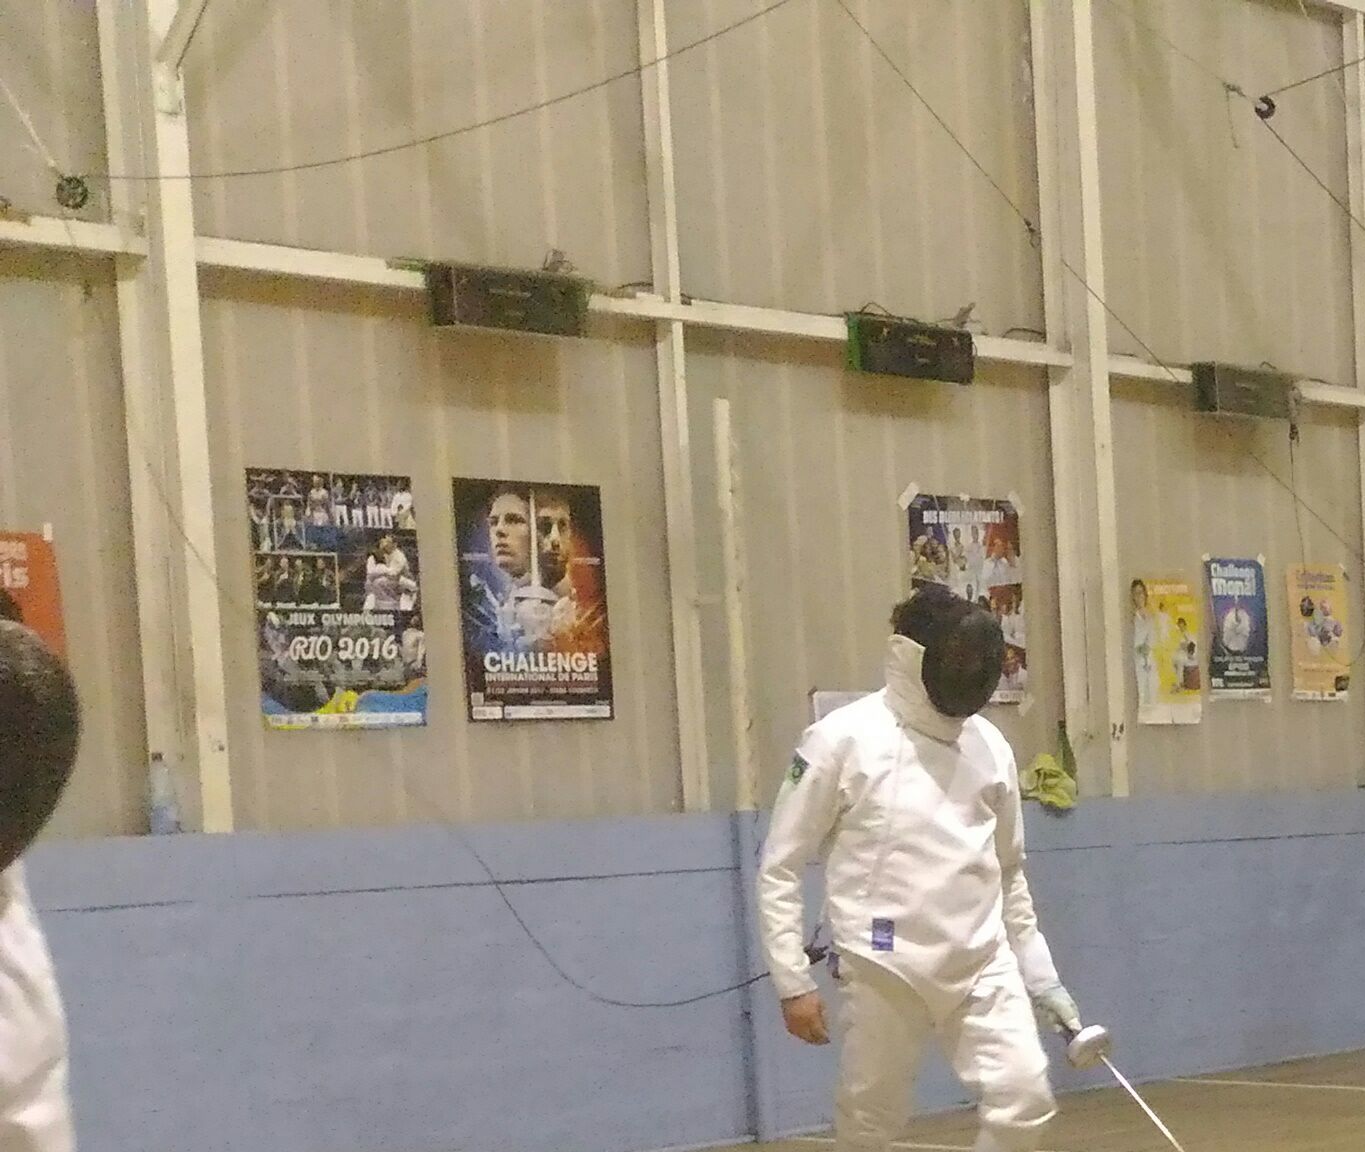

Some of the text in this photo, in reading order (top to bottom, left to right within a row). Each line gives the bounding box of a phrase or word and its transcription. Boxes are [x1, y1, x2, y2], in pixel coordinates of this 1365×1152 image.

[289, 634, 399, 661] RIO 2016
[483, 651, 599, 673] CHALLENGE
